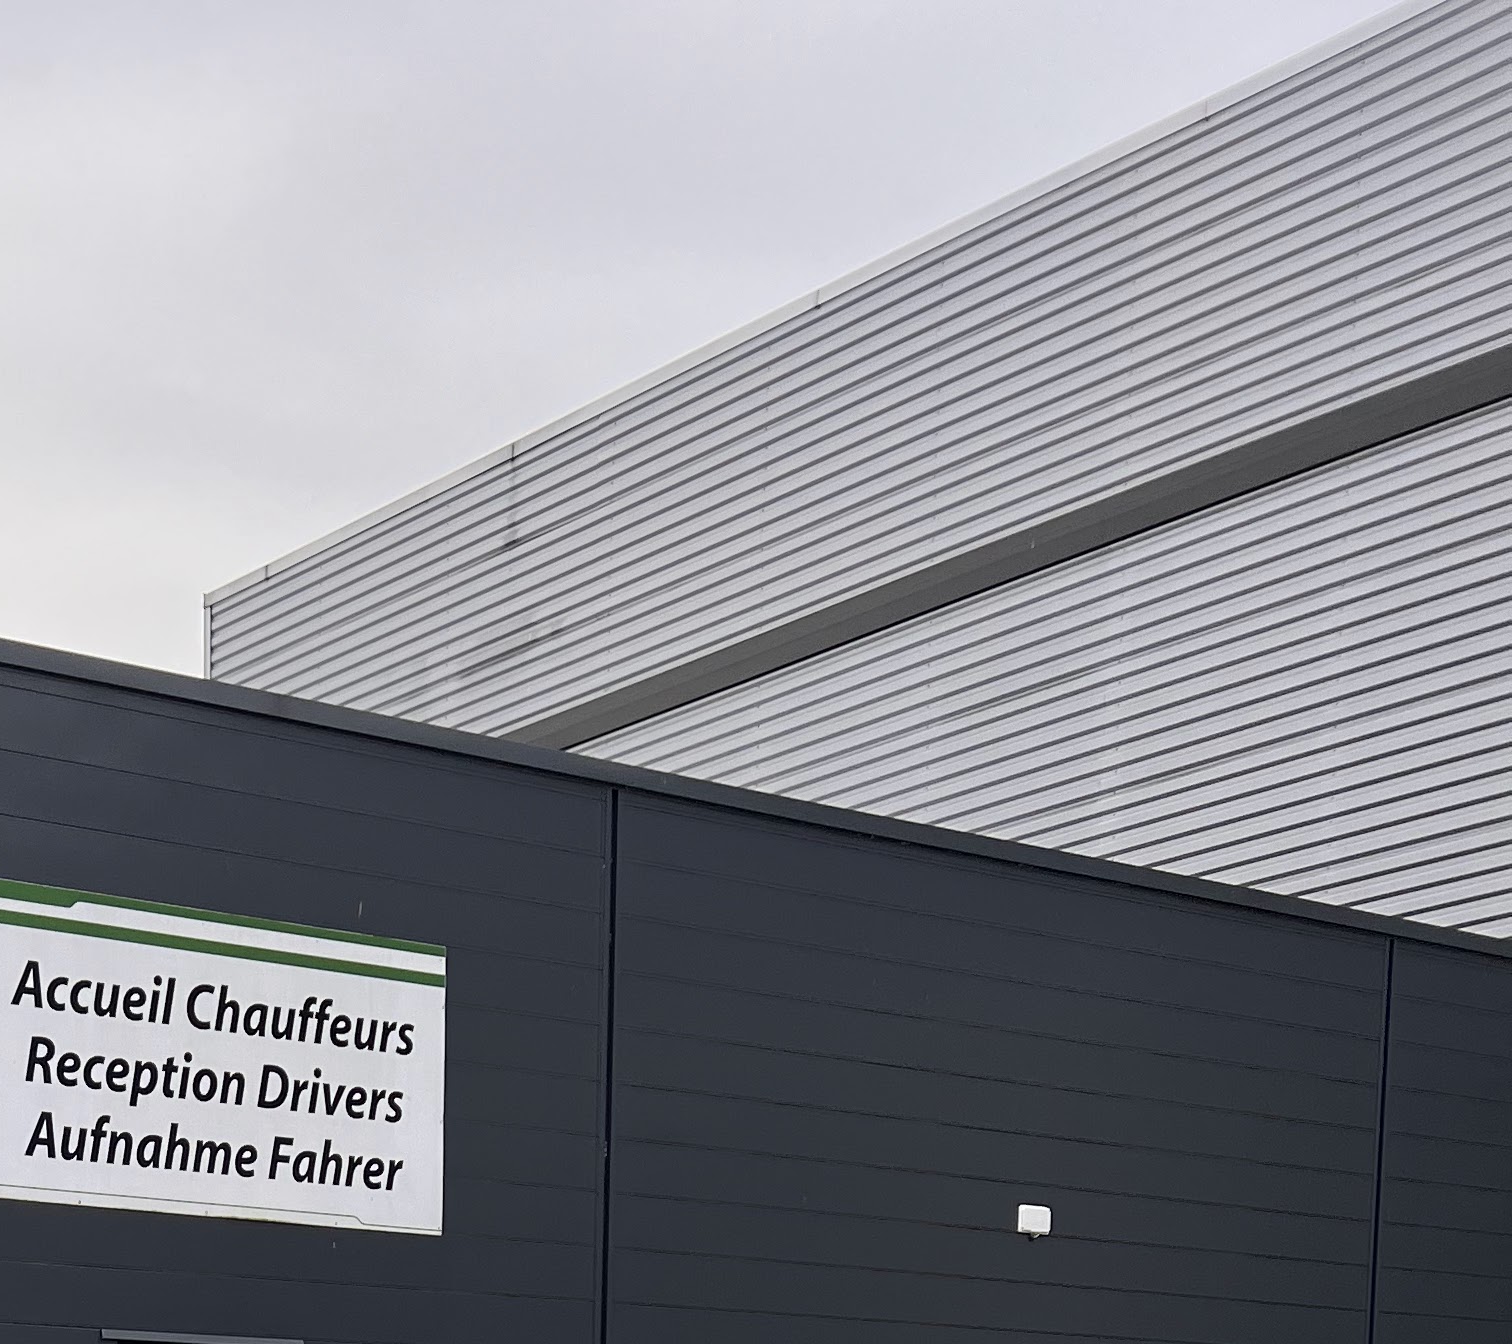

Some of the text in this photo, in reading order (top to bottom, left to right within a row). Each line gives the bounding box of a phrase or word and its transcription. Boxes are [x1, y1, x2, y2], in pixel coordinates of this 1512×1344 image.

[10, 959, 416, 1056] Accueil Chauffeurs
[24, 1036, 405, 1124] Reception Drivers
[24, 1111, 405, 1191] Aufnahme Fahrer
